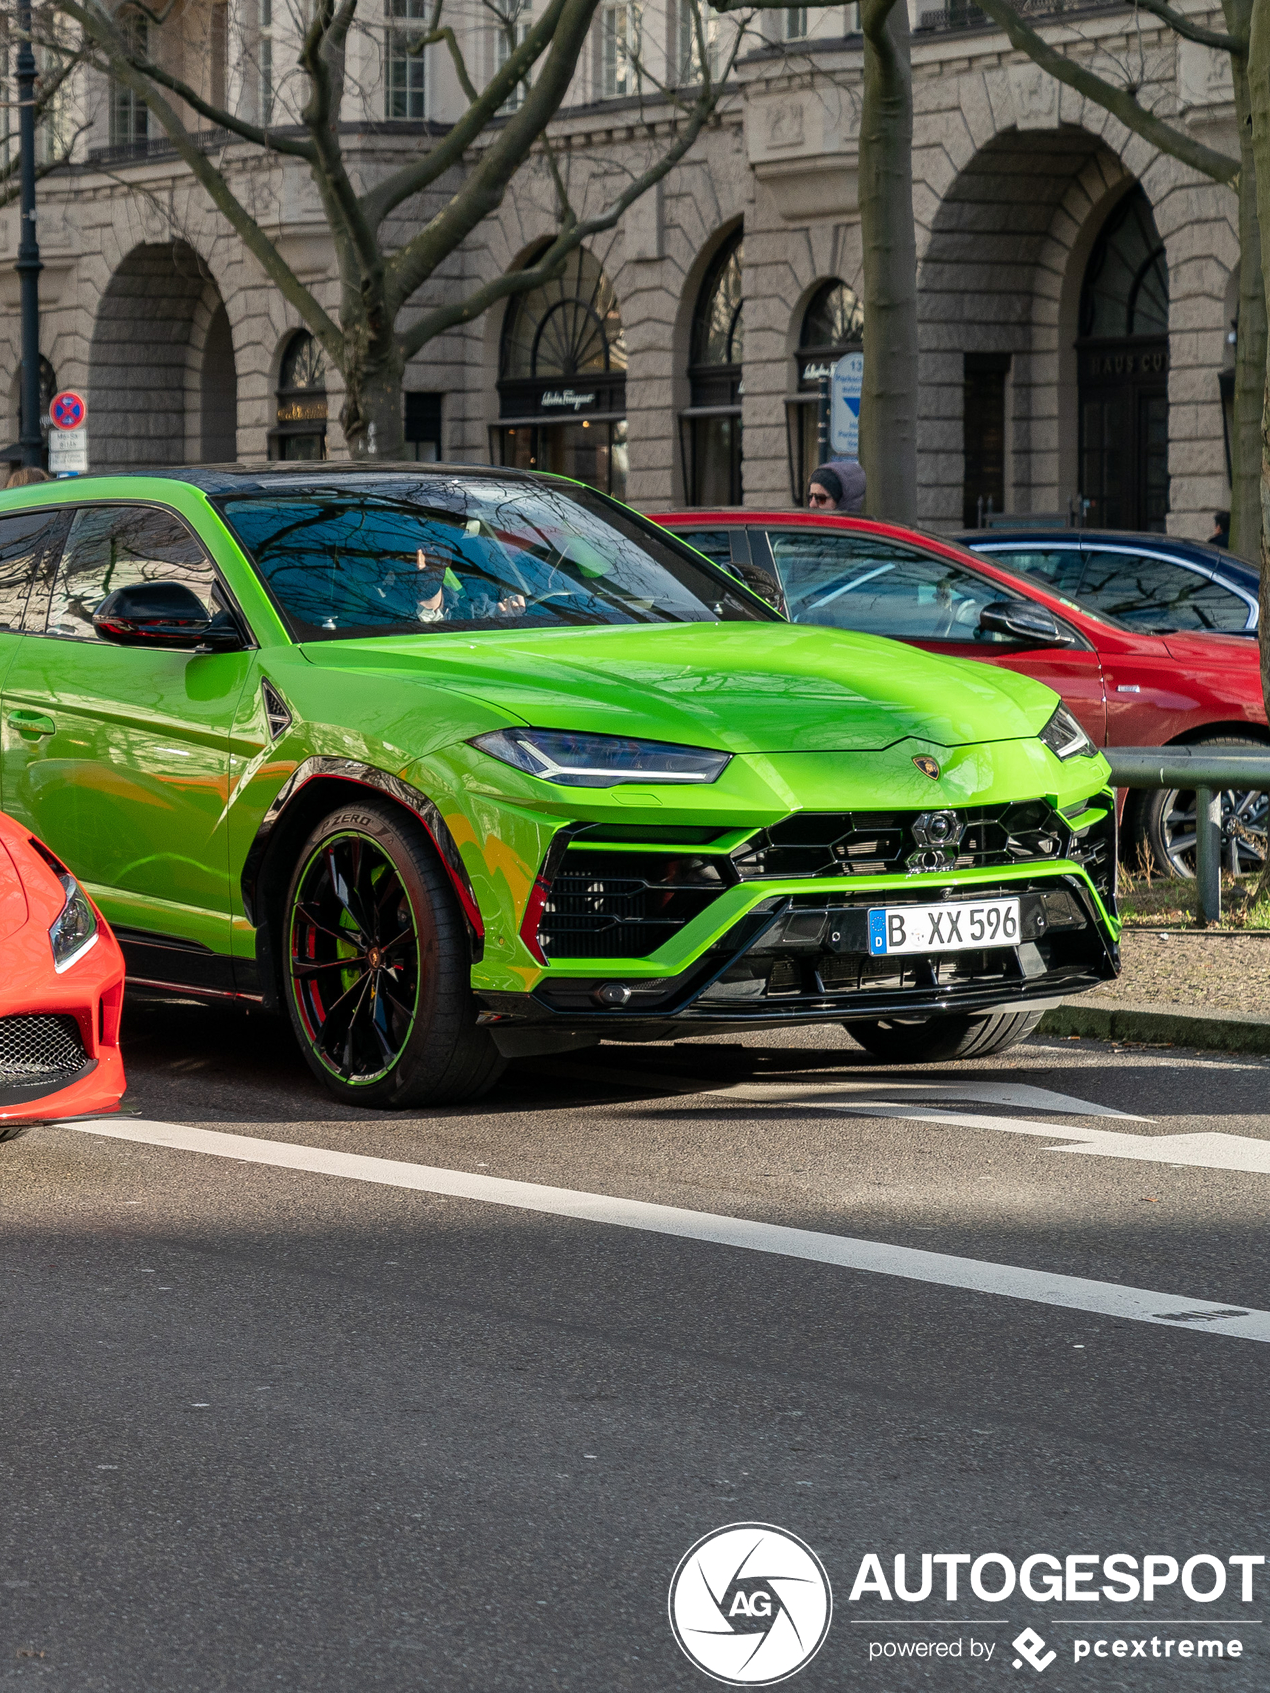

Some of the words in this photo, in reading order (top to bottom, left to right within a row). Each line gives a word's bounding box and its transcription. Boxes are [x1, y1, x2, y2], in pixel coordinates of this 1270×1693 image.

[1141, 352, 1170, 373] CU
[331, 813, 372, 827] ZERO
[875, 936, 883, 947] D
[888, 914, 907, 947] B
[927, 910, 963, 945] XX
[969, 906, 1017, 941] 596
